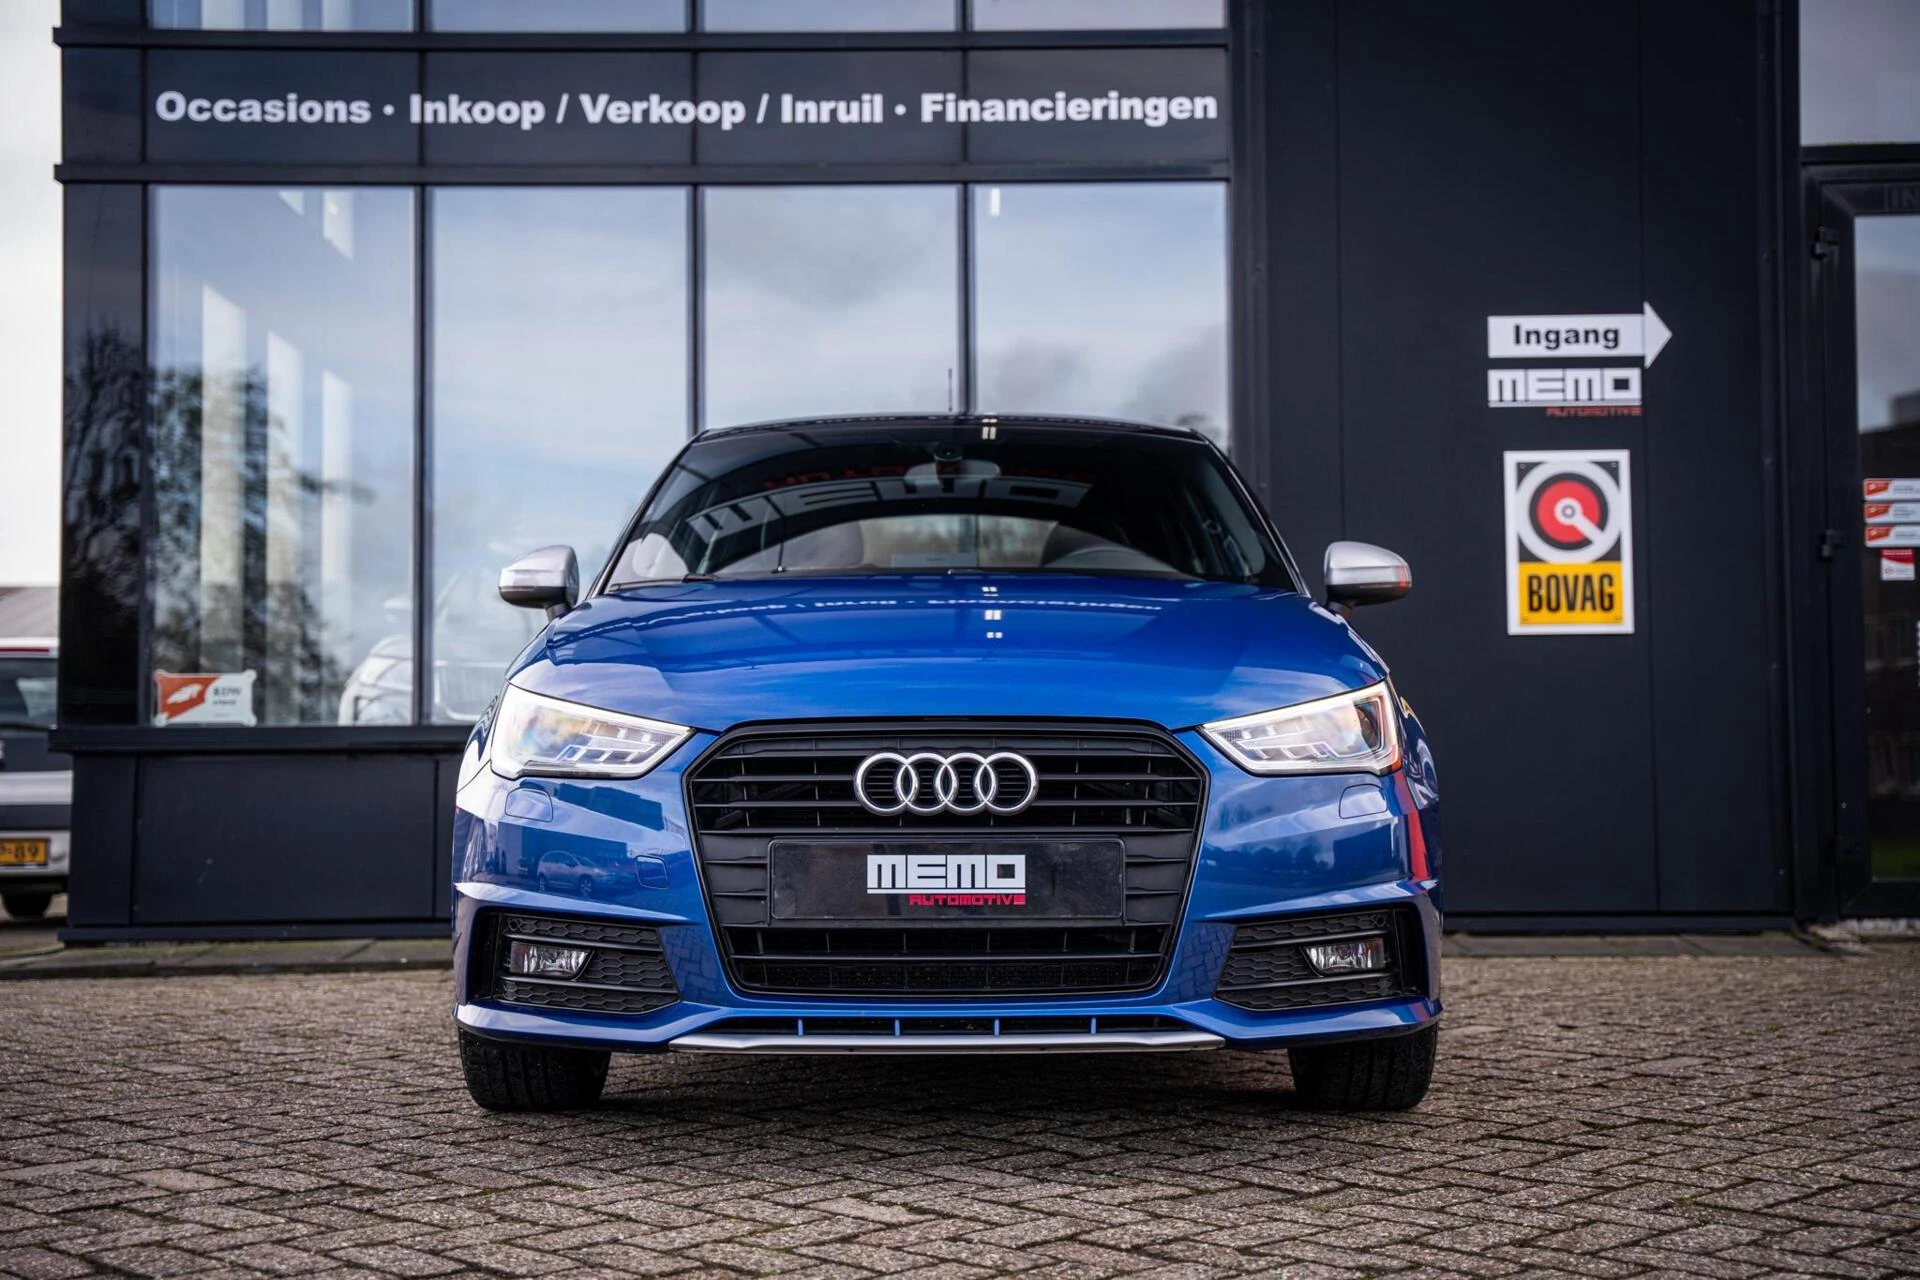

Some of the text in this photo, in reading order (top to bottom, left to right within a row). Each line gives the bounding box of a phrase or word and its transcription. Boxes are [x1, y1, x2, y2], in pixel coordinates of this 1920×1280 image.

[156, 91, 372, 124] Occasions
[410, 94, 546, 131] Inkoop
[578, 93, 746, 131] Verkoop
[780, 93, 884, 124] Inruil
[920, 90, 1218, 128] Financieringen
[1513, 324, 1620, 350] Ingang
[1488, 368, 1642, 402] MEMO
[1528, 574, 1615, 612] BOVAG
[867, 855, 1027, 889] MEMO
[909, 894, 1027, 906] AUTOMOTIVE
